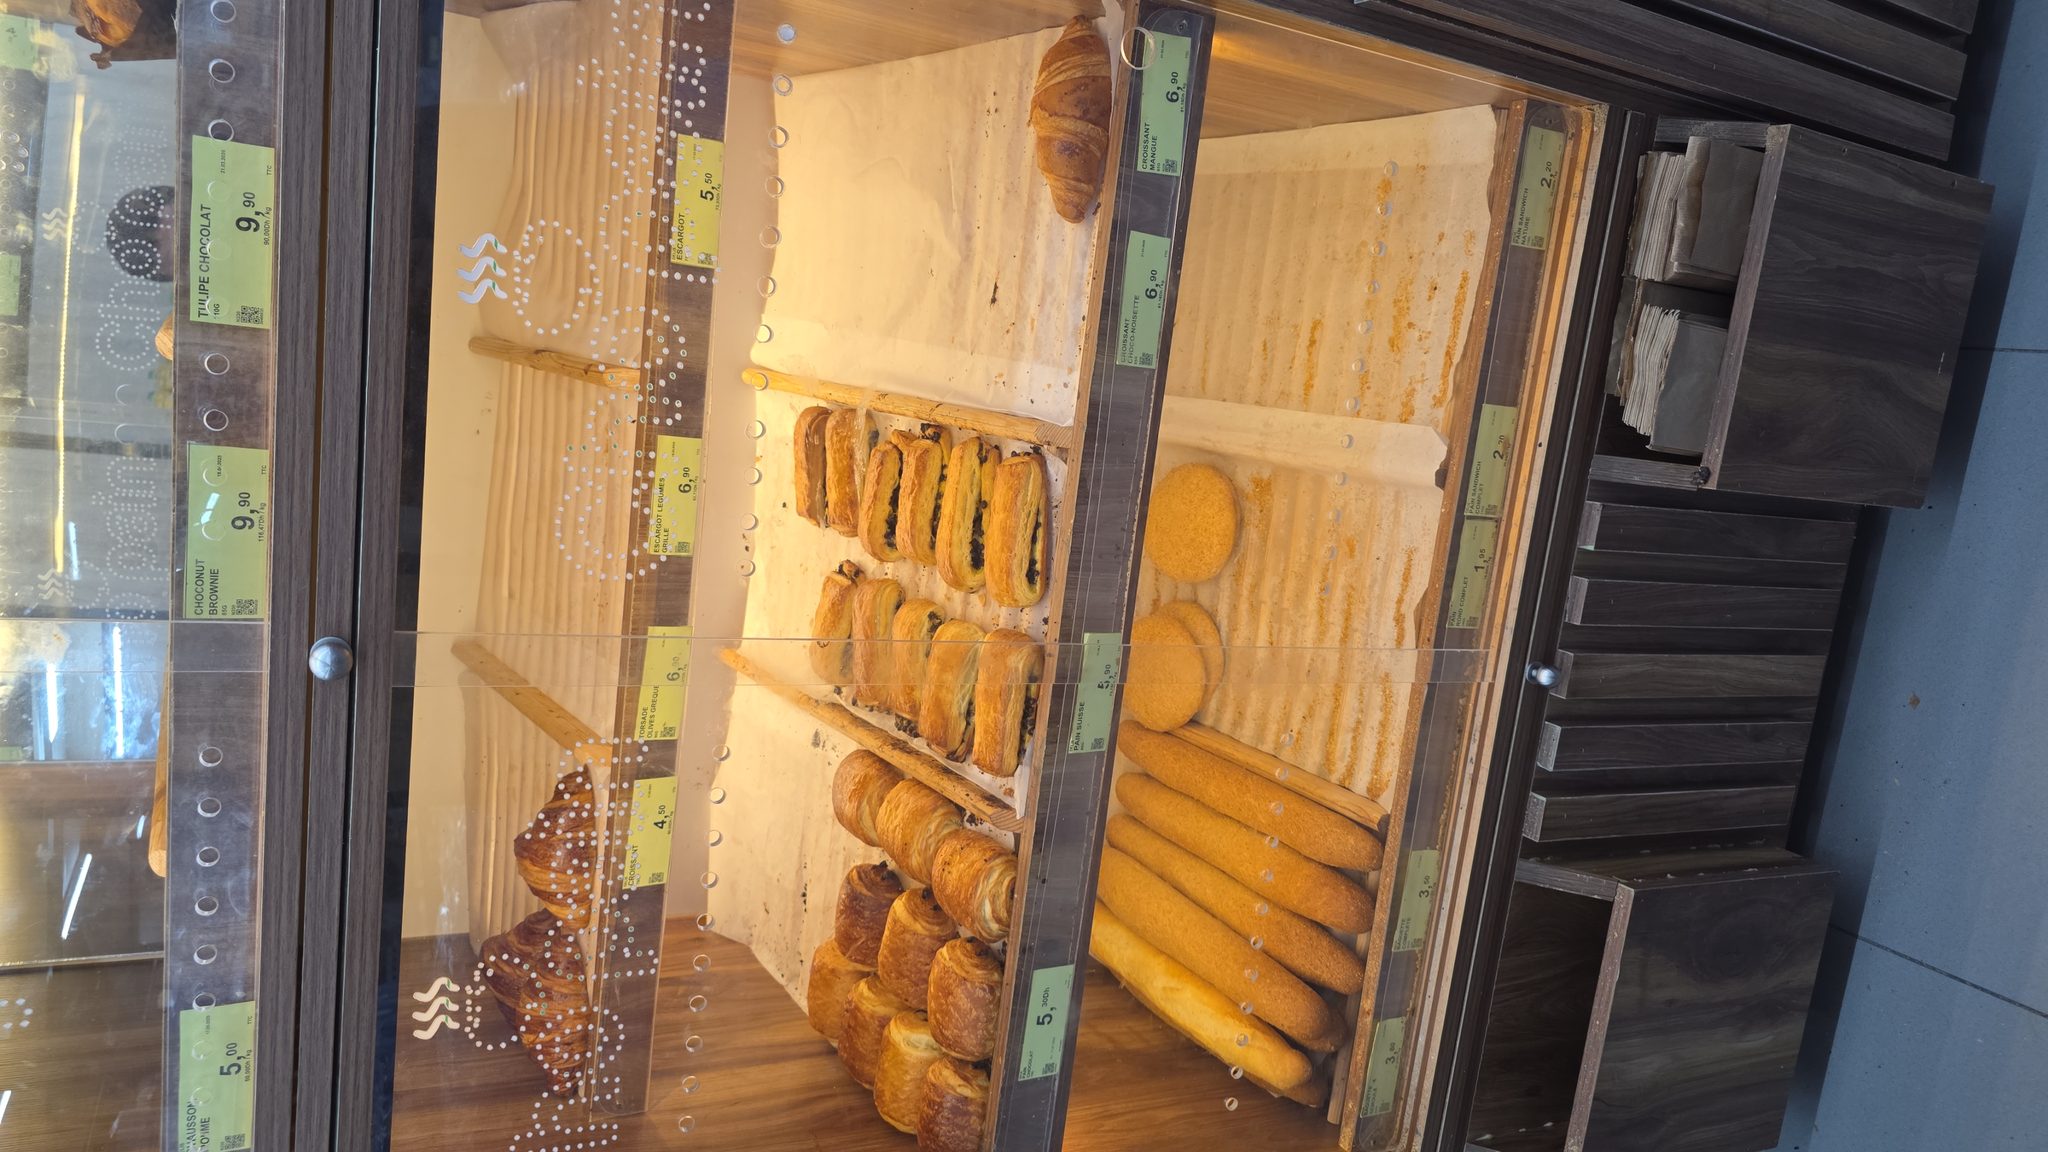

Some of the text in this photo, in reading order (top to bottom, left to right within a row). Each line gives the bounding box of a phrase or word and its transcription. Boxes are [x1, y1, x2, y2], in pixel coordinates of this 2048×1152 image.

[1166, 71, 1184, 103] 6,90
[1141, 122, 1150, 170] CROISSANT
[1148, 135, 1158, 171] MANGUE
[700, 172, 718, 201] 5,50
[1540, 160, 1555, 188] 2,20
[234, 191, 265, 233] 9,90
[1513, 187, 1529, 244] PAIN SANDWICH
[1520, 215, 1531, 246] NATURE
[676, 212, 686, 260] ESCARGOT
[198, 203, 212, 318] TULIPE CHOCOLAT
[1144, 269, 1161, 300] 6,90
[1120, 317, 1130, 363] CROISSANT
[1128, 294, 1140, 364] CHOCO-NOISETTE
[678, 466, 694, 494] 6,90
[1471, 460, 1483, 497] SANDWICH
[230, 491, 260, 531] 9,90
[653, 477, 666, 553] ESCARGOT LEGUMES
[1468, 498, 1476, 514] PAIN
[662, 527, 670, 553] GRILLE
[194, 558, 205, 616] CHOCONUT
[208, 568, 220, 616] BROWNIE
[1456, 608, 1464, 626] ROND
[1460, 576, 1469, 606] COMPLET
[1450, 611, 1458, 626] PAIN
[638, 706, 649, 738] TORSADE
[646, 714, 656, 738] OLIVES
[1074, 701, 1086, 751] PAIN SUISSE
[653, 804, 670, 830] 4,50
[627, 845, 639, 886] CROISSNT
[219, 1042, 246, 1076] 5,00
